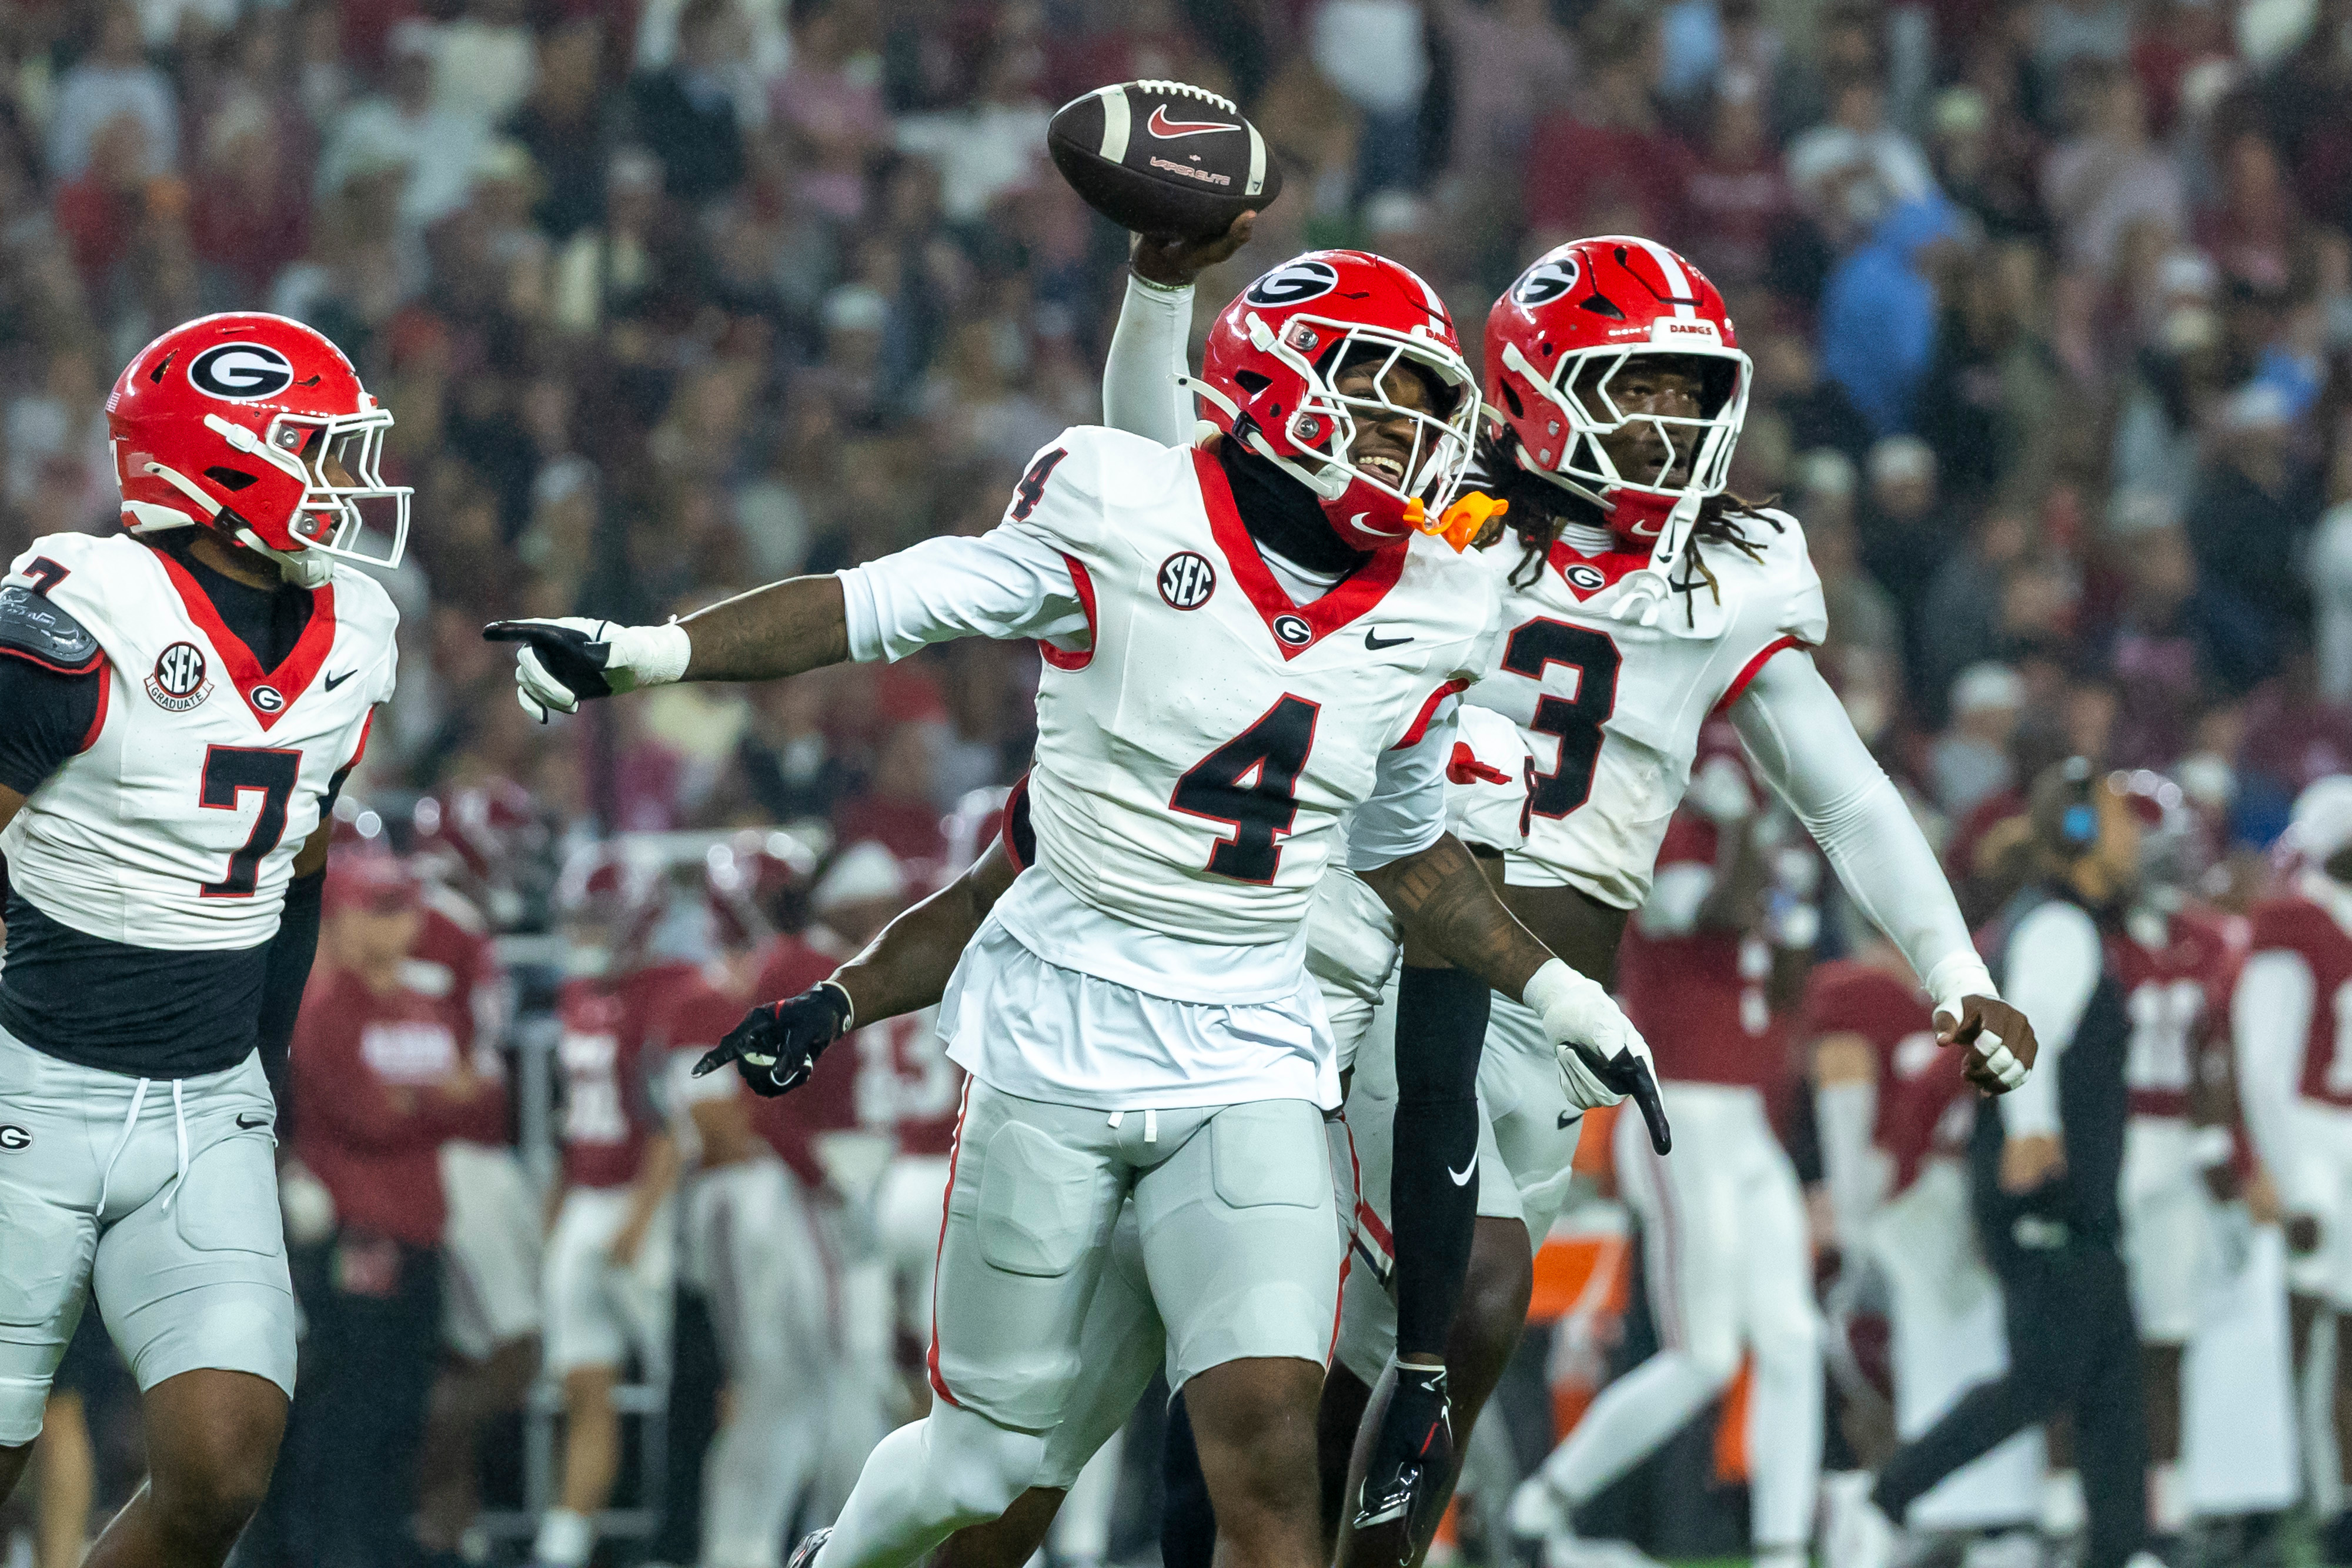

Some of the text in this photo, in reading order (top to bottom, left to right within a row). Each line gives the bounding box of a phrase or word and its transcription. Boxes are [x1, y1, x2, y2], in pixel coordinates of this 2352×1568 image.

[1150, 156, 1231, 185] VAPOR ELITE
[1246, 261, 1335, 305] G
[1512, 258, 1576, 304] G
[1670, 325, 1712, 335] DAWGS
[190, 344, 291, 397] G
[1011, 447, 1068, 522] 4
[22, 556, 71, 597] 7
[1162, 555, 1212, 606] SEC
[1566, 566, 1603, 589] G
[1274, 616, 1311, 644] G
[159, 645, 202, 693] SEC
[151, 687, 203, 710] GRADUATE
[252, 687, 283, 711] G
[1501, 616, 1623, 820] 3
[1168, 691, 1321, 885] 4
[199, 744, 303, 898] 7
[0, 1124, 32, 1149] G
